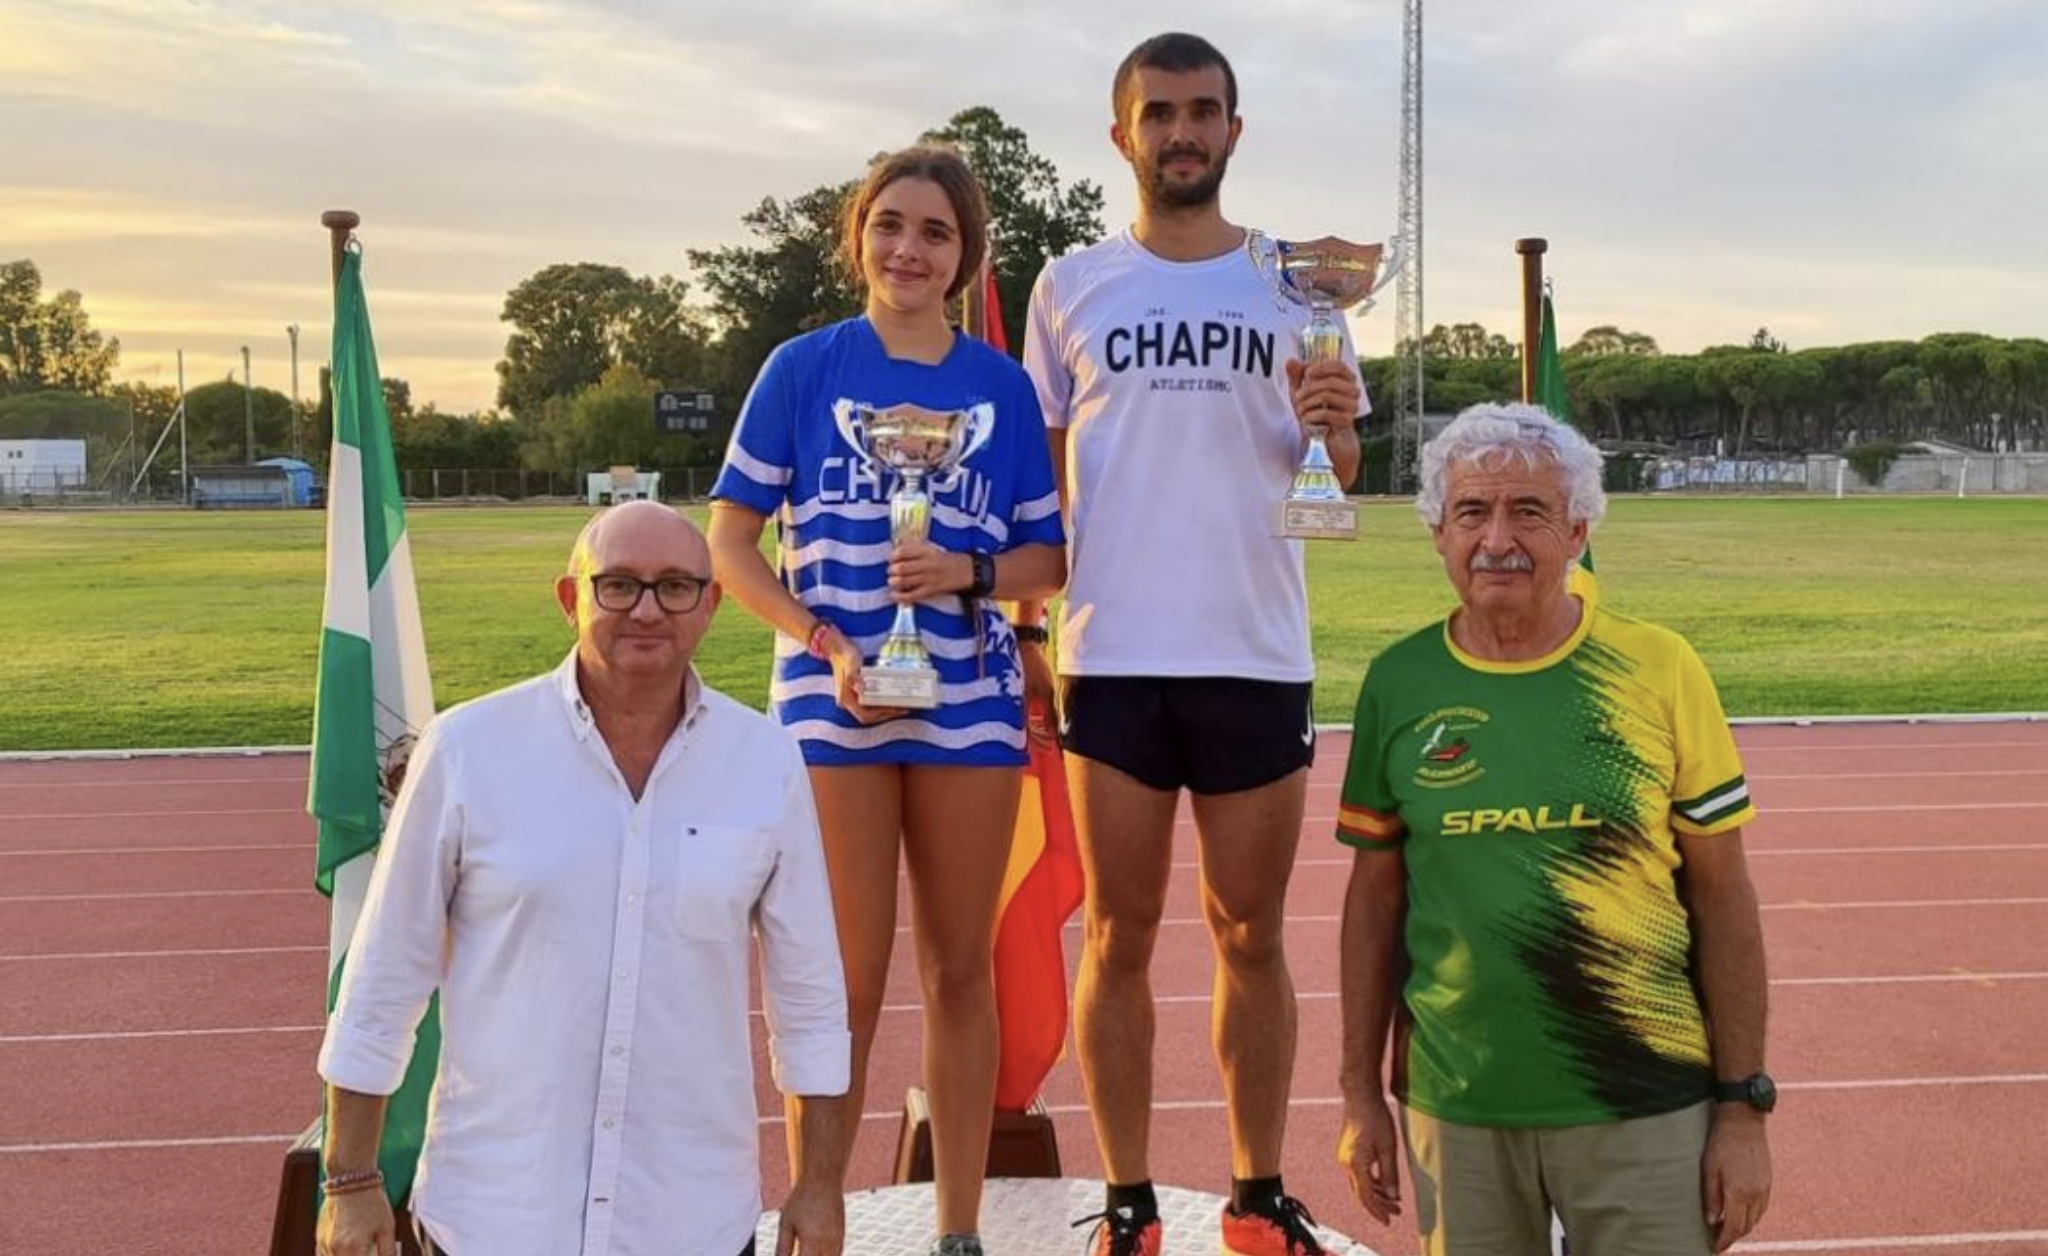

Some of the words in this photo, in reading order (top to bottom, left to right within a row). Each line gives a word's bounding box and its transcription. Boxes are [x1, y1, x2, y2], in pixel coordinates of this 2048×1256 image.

[1105, 320, 1275, 379] CHAPIN
[1150, 379, 1232, 393] ATLETISMO
[1440, 803, 1601, 836] SPALL
